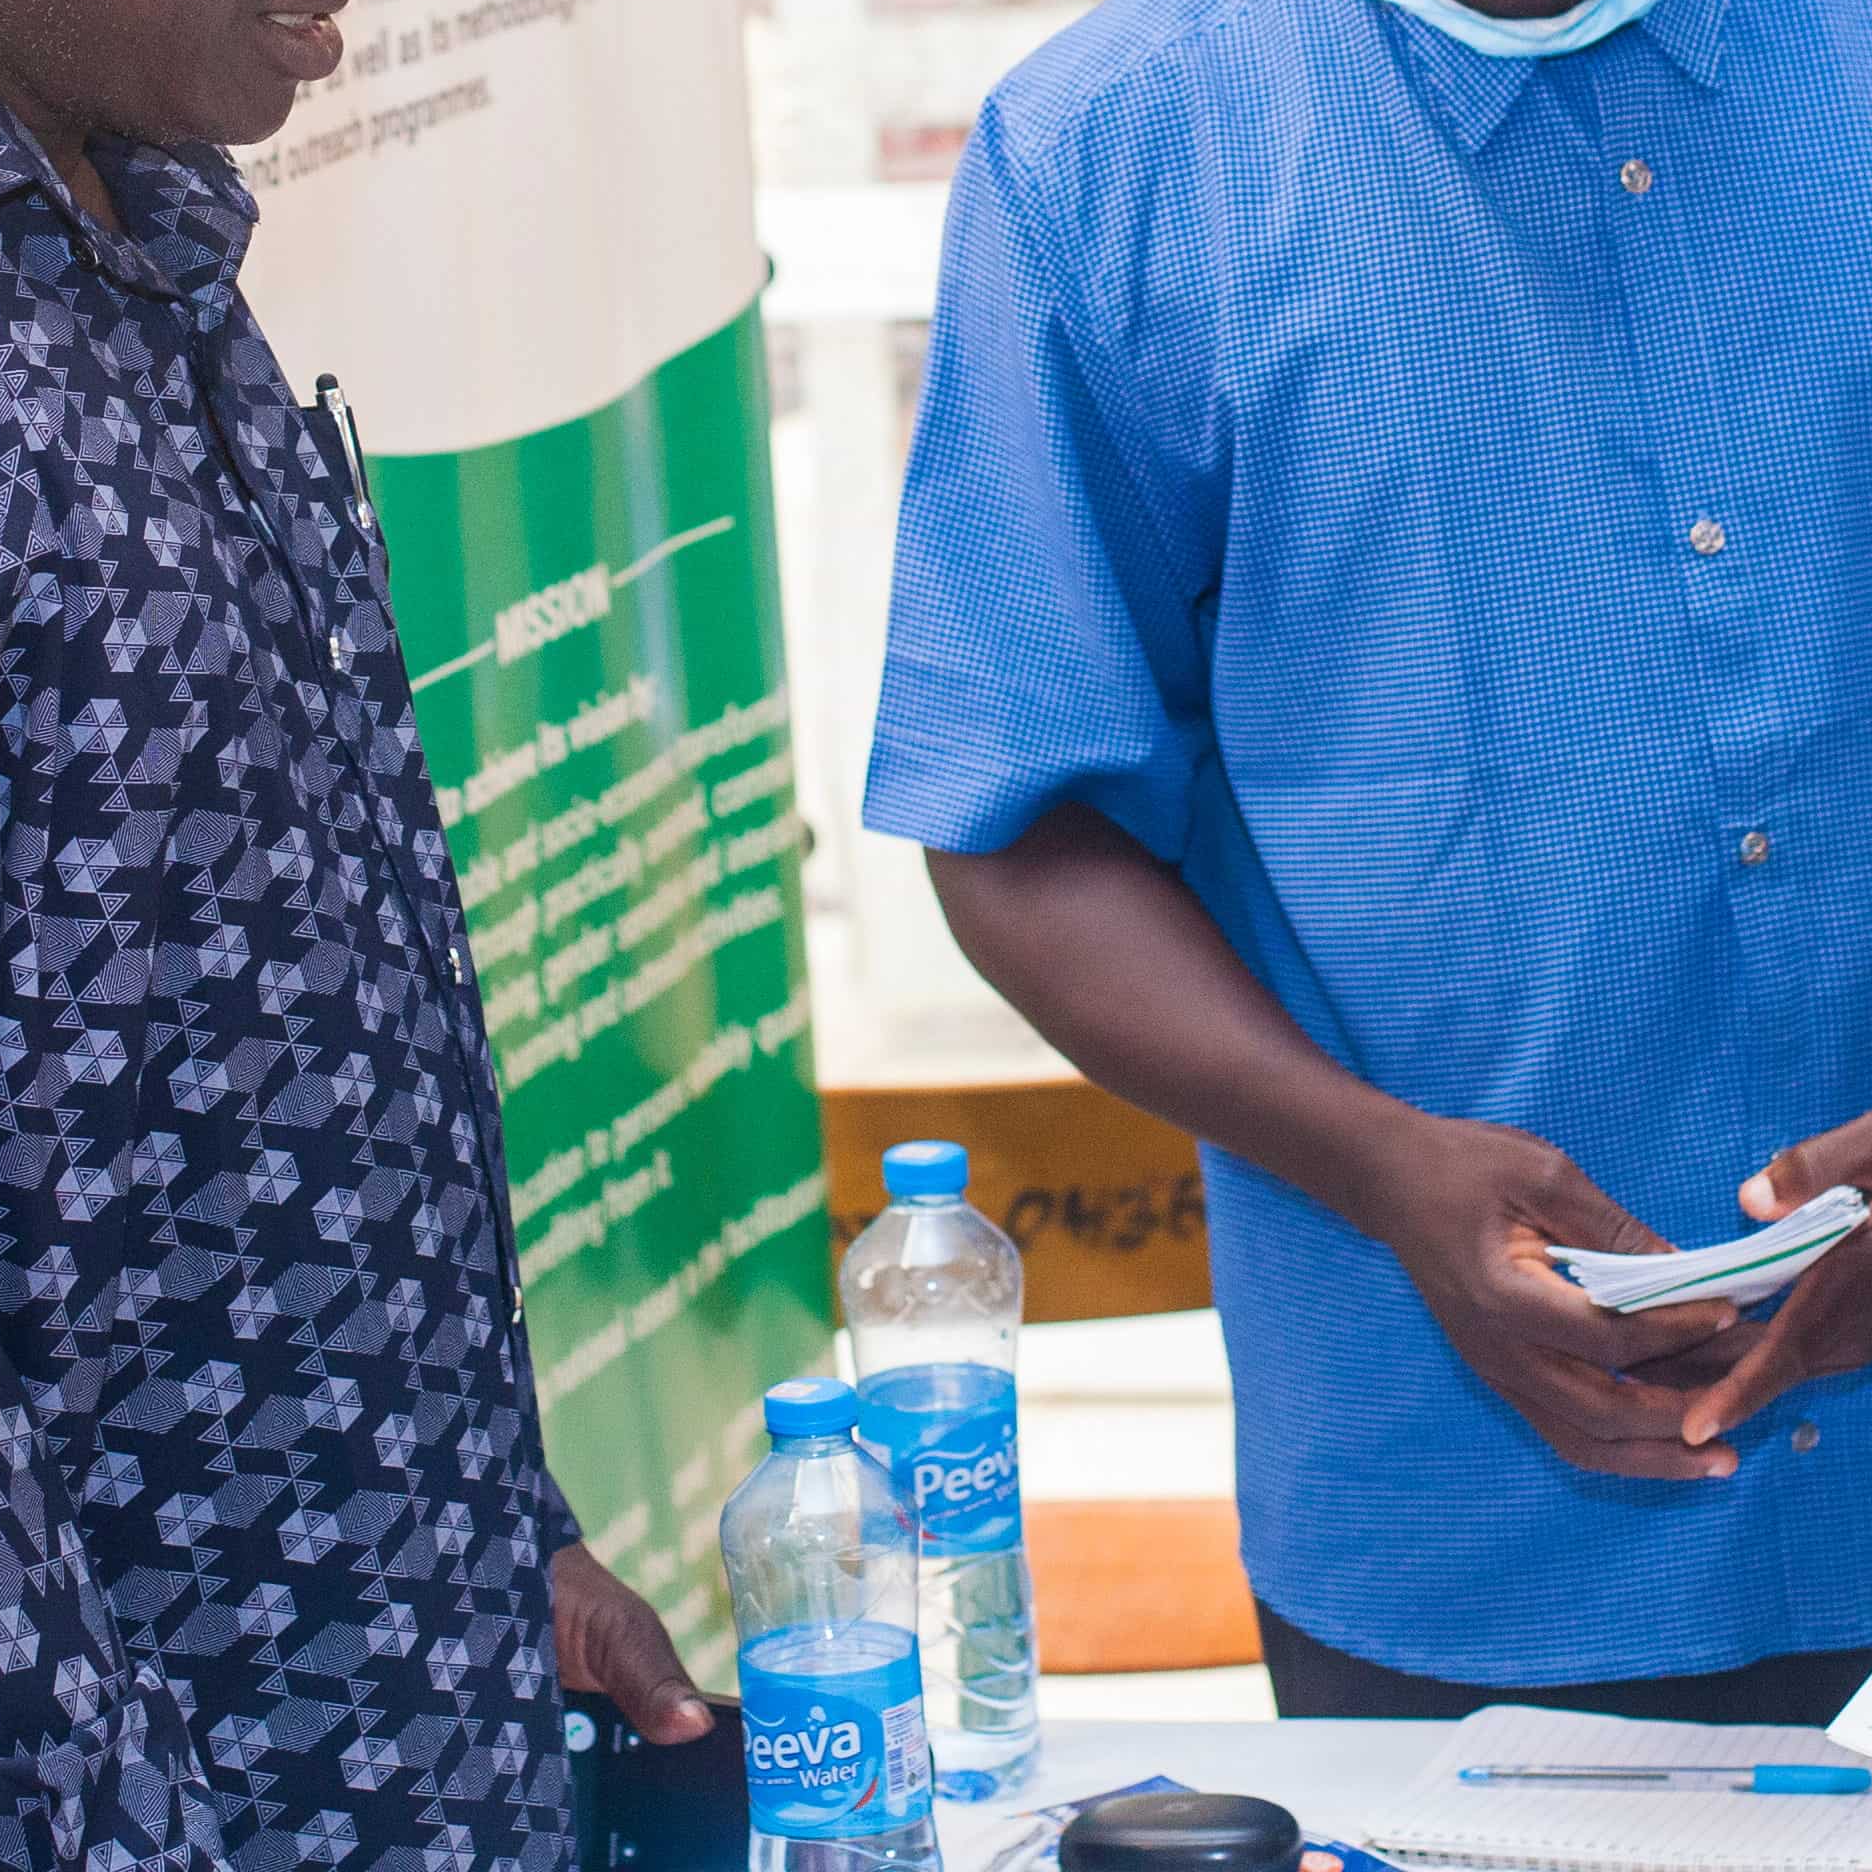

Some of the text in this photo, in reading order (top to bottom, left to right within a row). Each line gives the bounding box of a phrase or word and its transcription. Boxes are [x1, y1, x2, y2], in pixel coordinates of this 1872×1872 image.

[494, 562, 613, 665] MISSION
[913, 1441, 1018, 1509] Peev
[798, 1761, 863, 1790] Water
